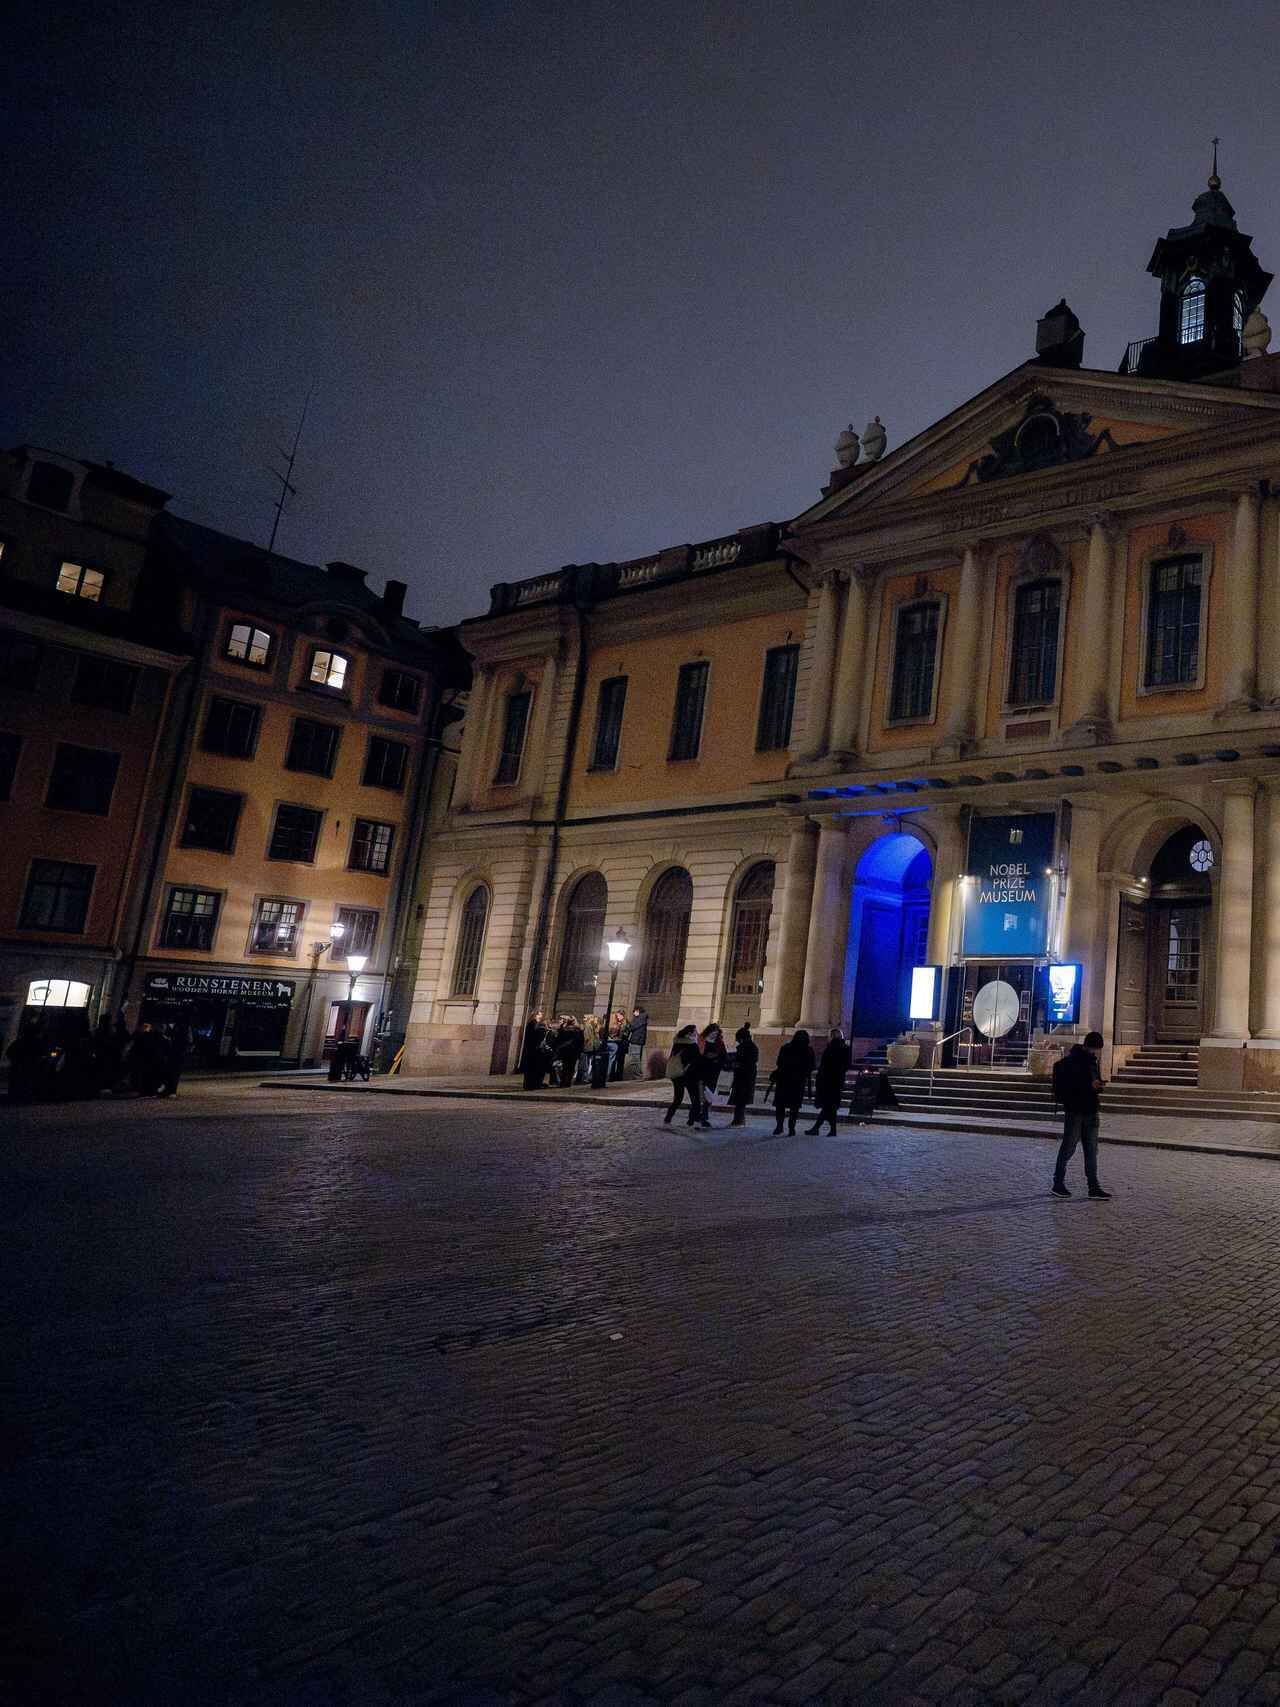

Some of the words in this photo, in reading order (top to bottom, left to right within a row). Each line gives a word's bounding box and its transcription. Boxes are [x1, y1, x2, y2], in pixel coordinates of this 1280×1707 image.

[989, 863, 1031, 876] NOBEL
[992, 877, 1025, 889] PRIZE
[979, 889, 1036, 903] MUSEUM
[176, 976, 273, 991] RUNSTENEN
